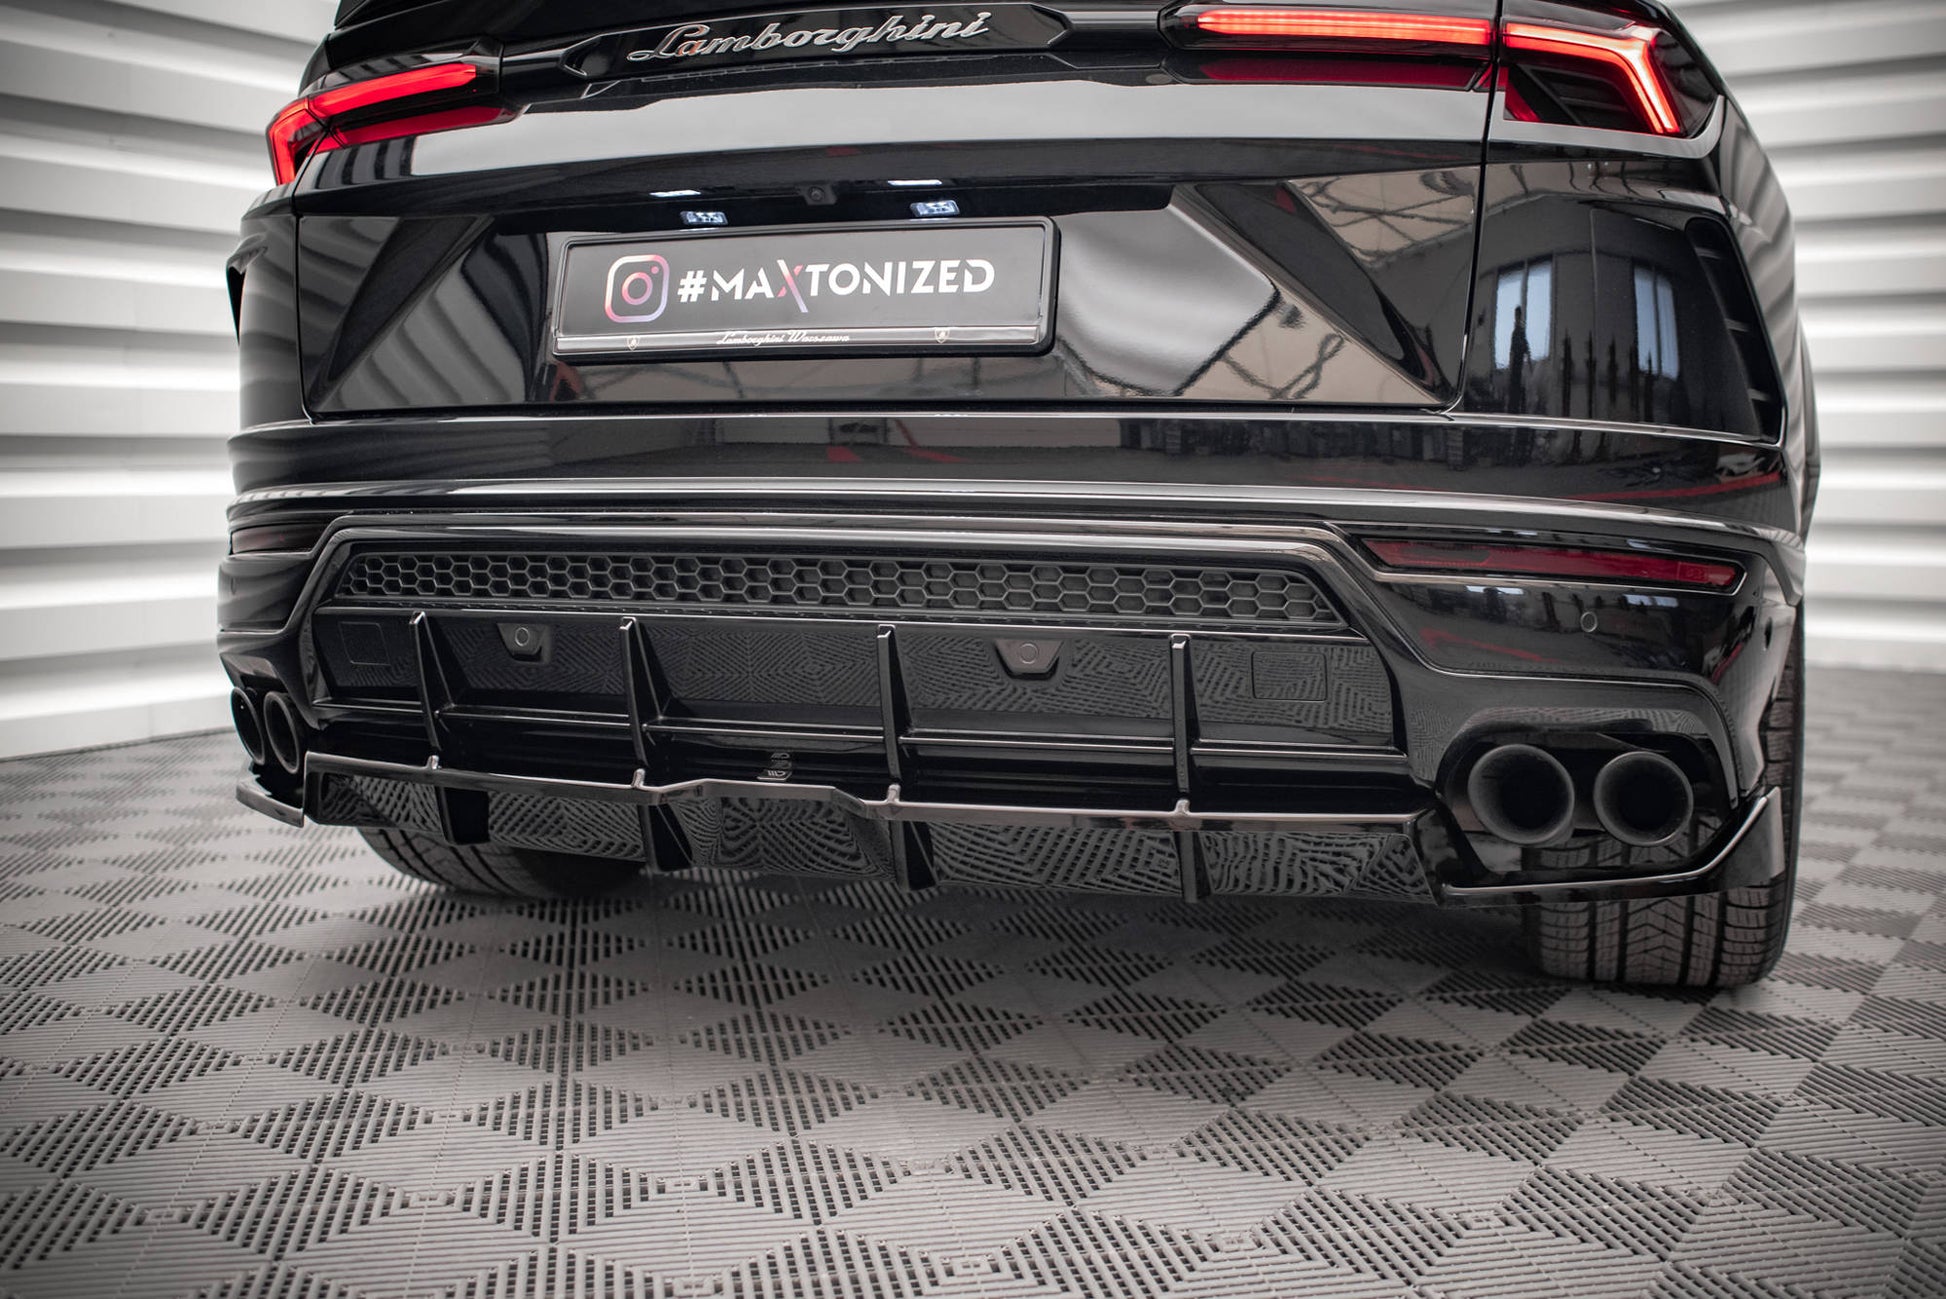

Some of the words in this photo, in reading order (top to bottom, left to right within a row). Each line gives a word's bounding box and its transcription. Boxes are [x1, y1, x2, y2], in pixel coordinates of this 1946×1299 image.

[626, 12, 992, 61] Lamborghini
[677, 259, 996, 313] #MAXTONIZED
[716, 331, 785, 347] Lamborghini
